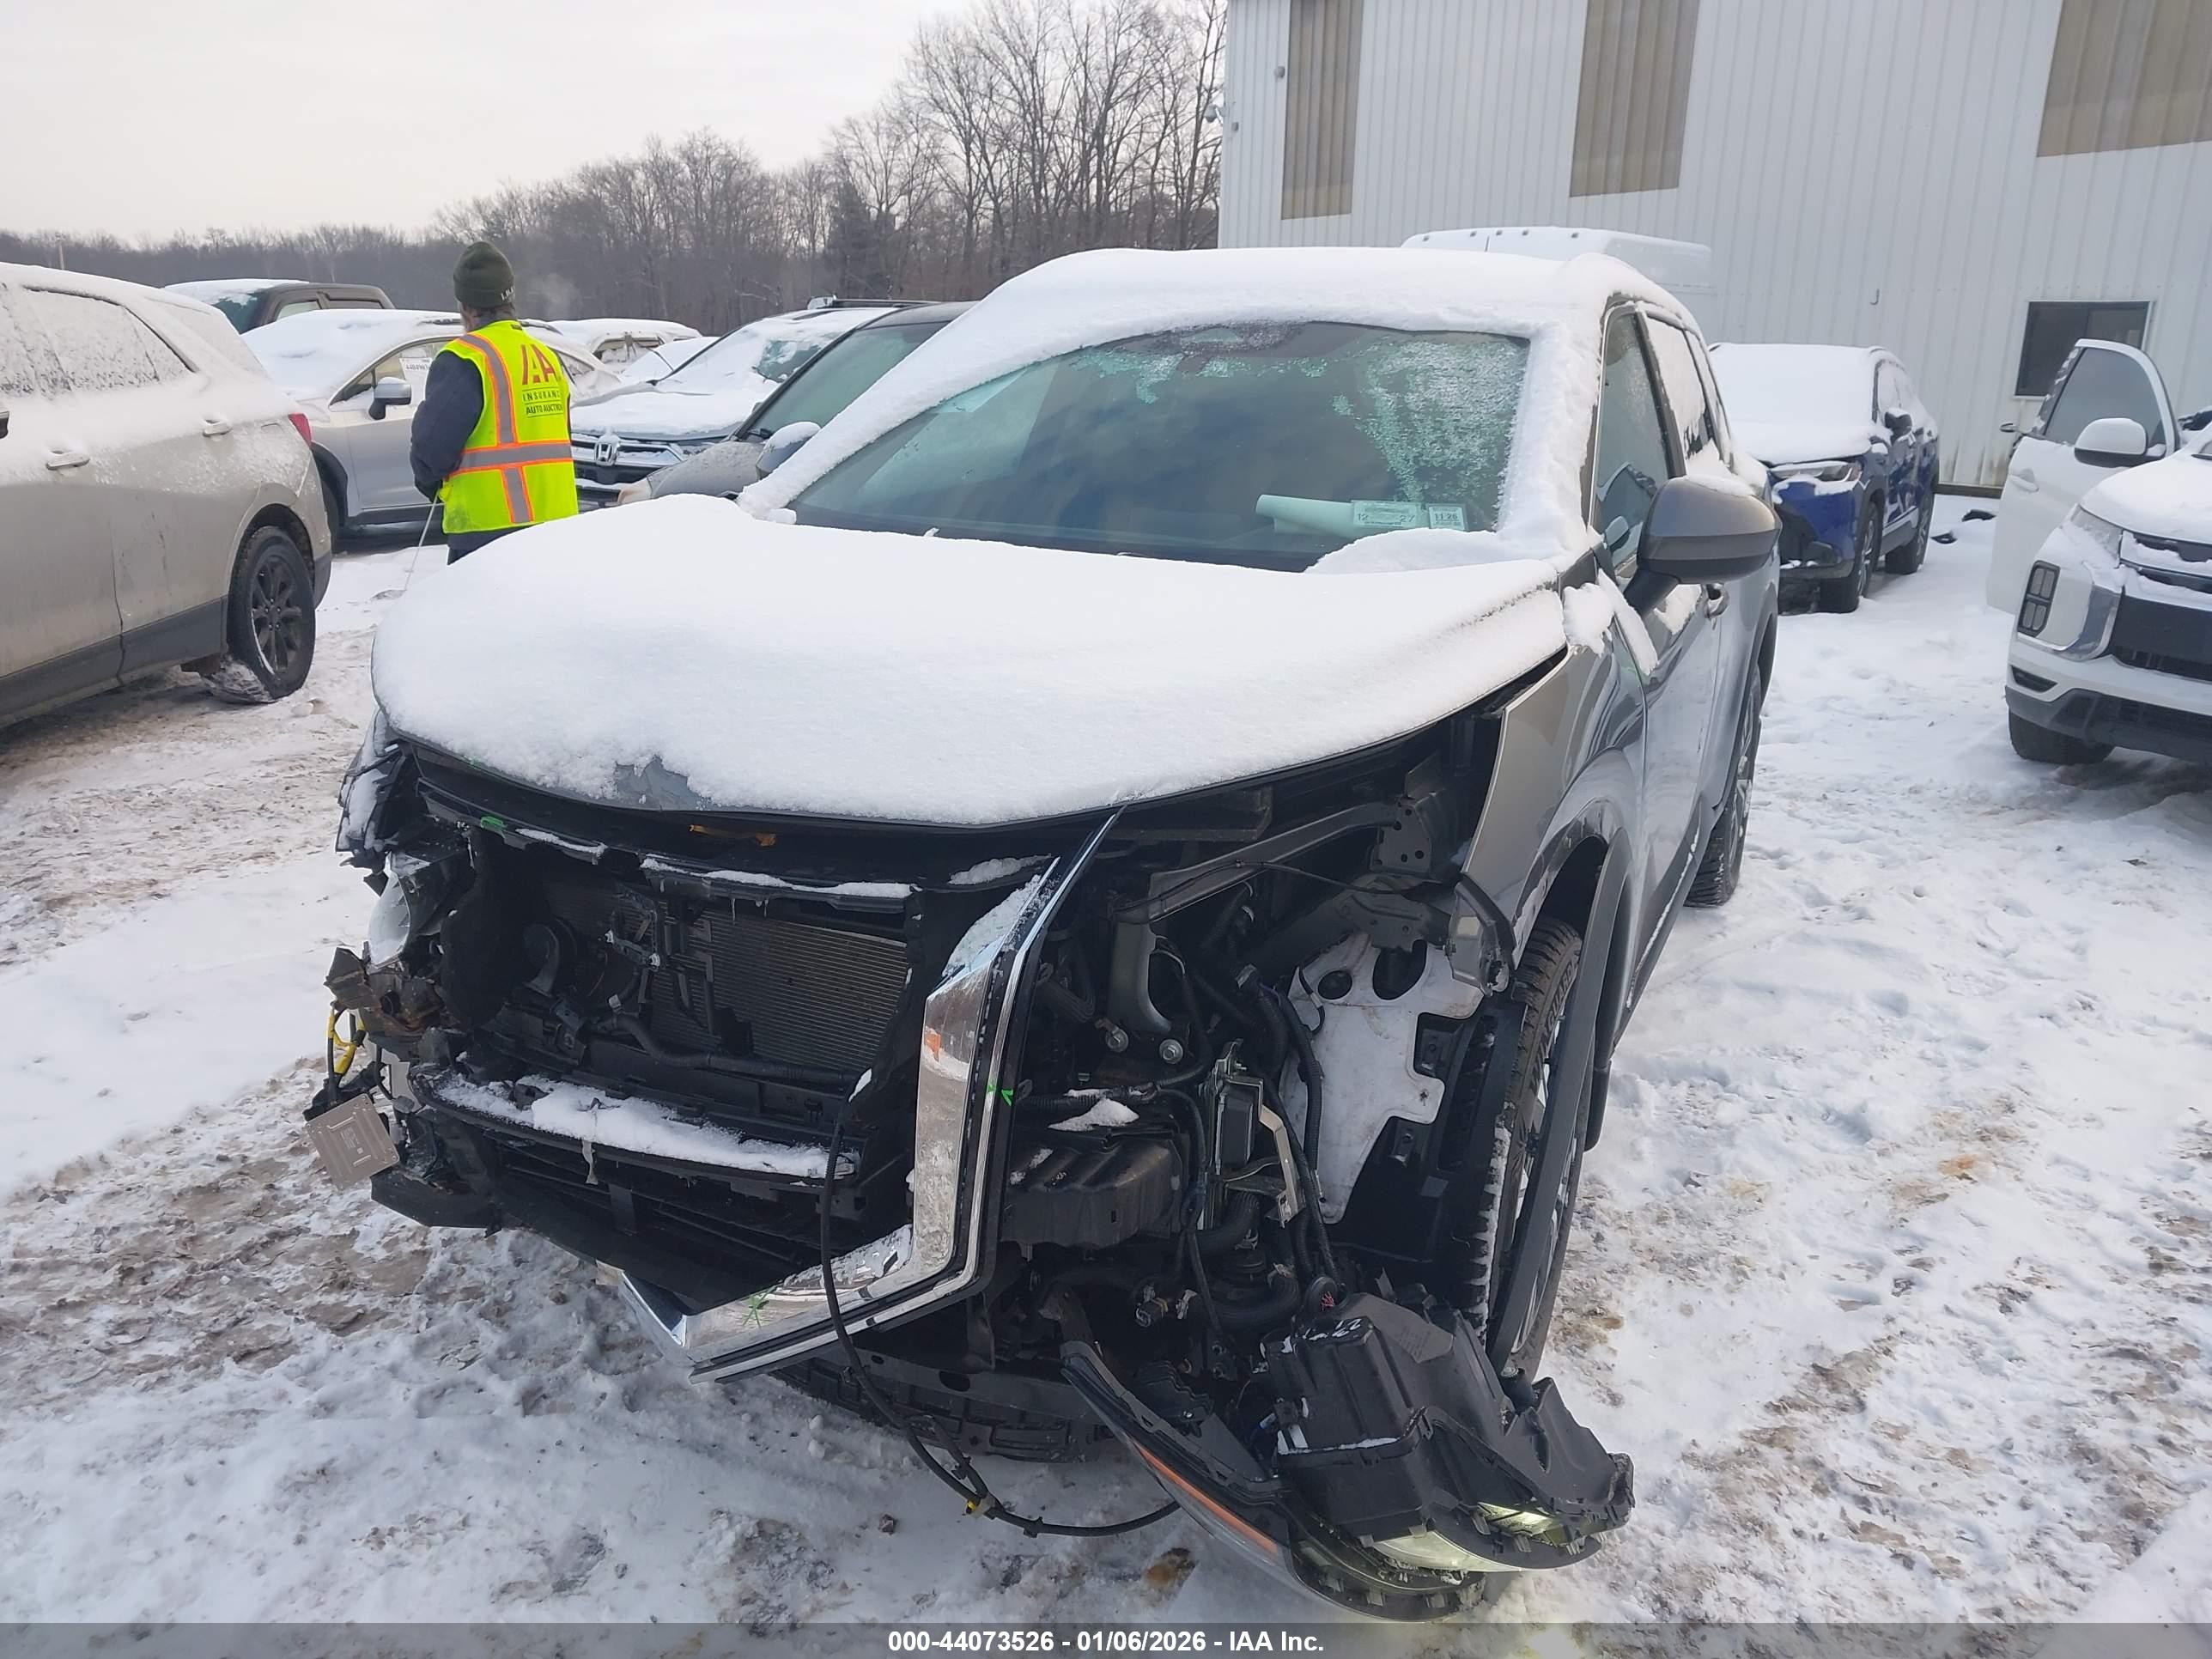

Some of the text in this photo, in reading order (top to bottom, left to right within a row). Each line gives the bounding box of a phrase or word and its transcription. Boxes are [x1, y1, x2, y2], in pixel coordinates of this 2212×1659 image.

[526, 404, 543, 416] AUTO
[1358, 513, 1369, 521] 12
[1400, 514, 1415, 523] 27
